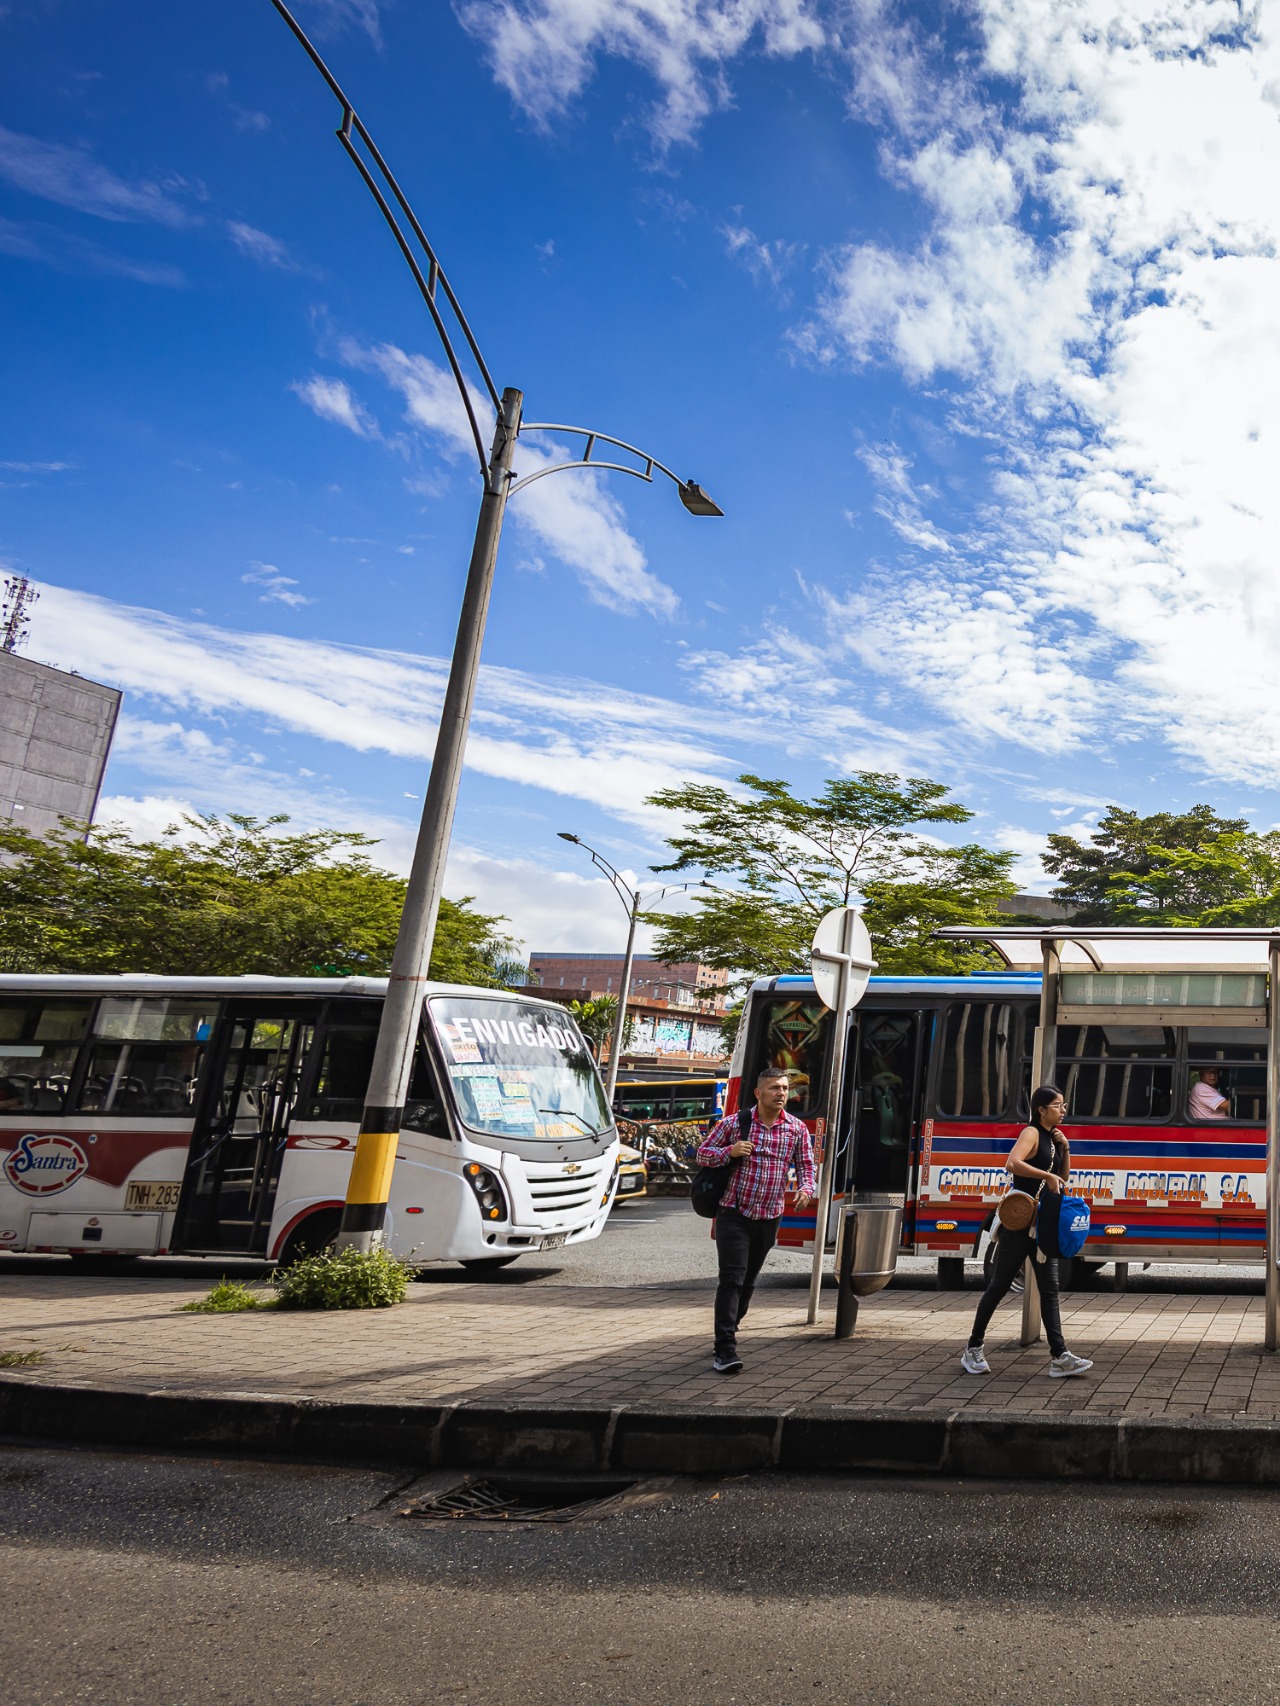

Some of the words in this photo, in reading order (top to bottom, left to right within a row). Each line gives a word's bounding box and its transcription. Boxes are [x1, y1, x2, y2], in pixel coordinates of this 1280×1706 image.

[451, 1017, 581, 1053] ENVIGADO
[468, 1065, 497, 1075] VEGAS
[14, 1136, 77, 1173] Santra
[1124, 1172, 1209, 1202] ROBLEDAL
